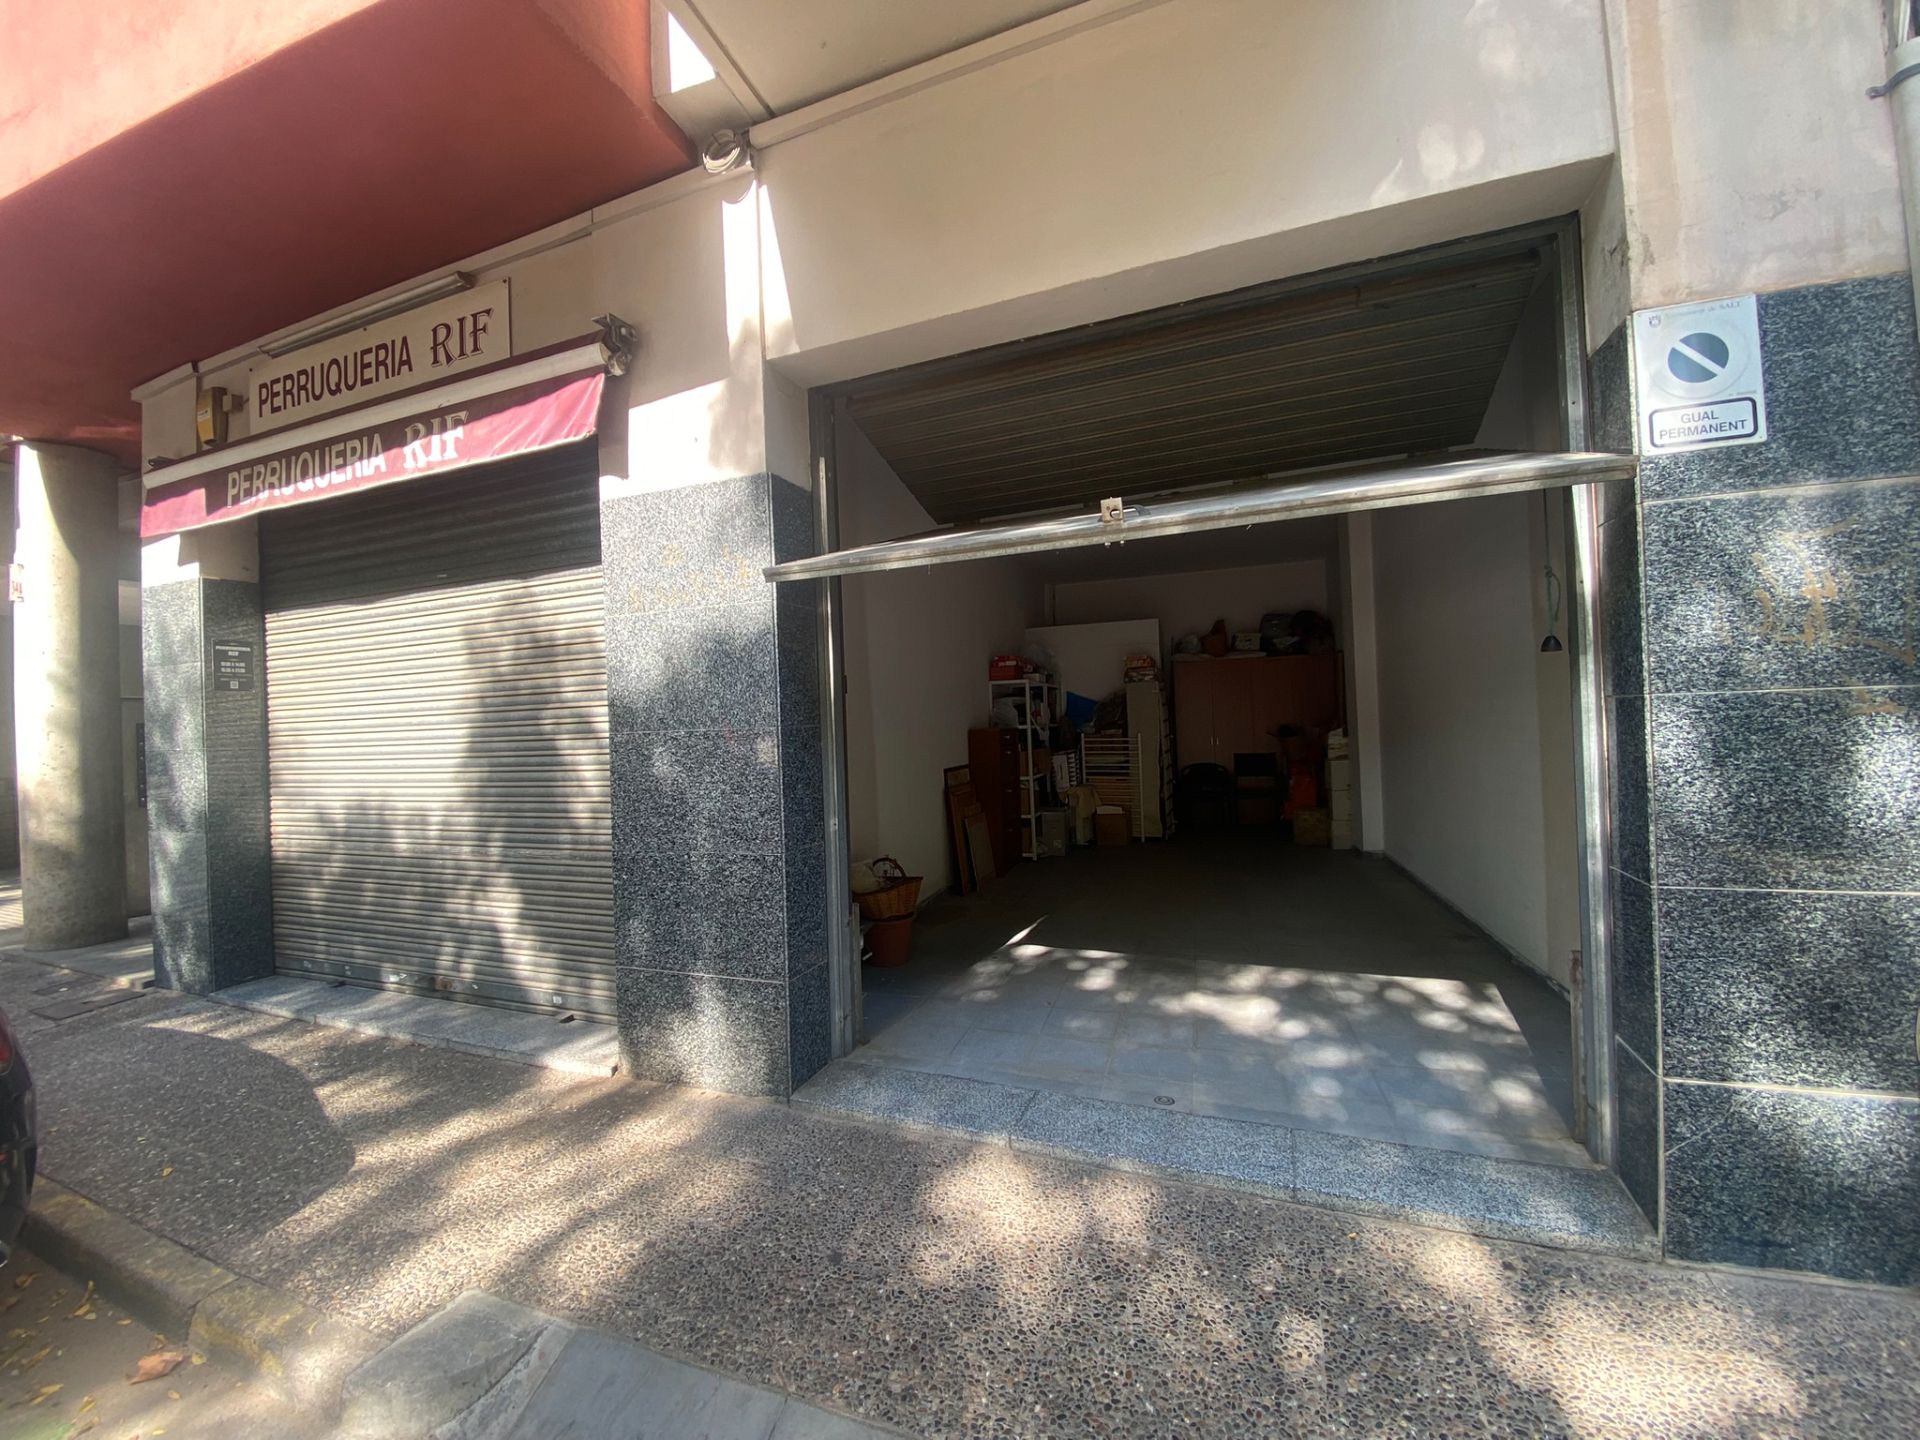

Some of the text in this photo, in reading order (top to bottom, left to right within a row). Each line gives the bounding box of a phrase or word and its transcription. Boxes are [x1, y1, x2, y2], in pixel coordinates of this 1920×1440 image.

[258, 307, 494, 418] PERRUQUERIA RIF
[1659, 419, 1748, 440] PERMANENT
[1681, 410, 1720, 424] GUAL
[226, 410, 470, 508] PERRUQUERIA RIF
